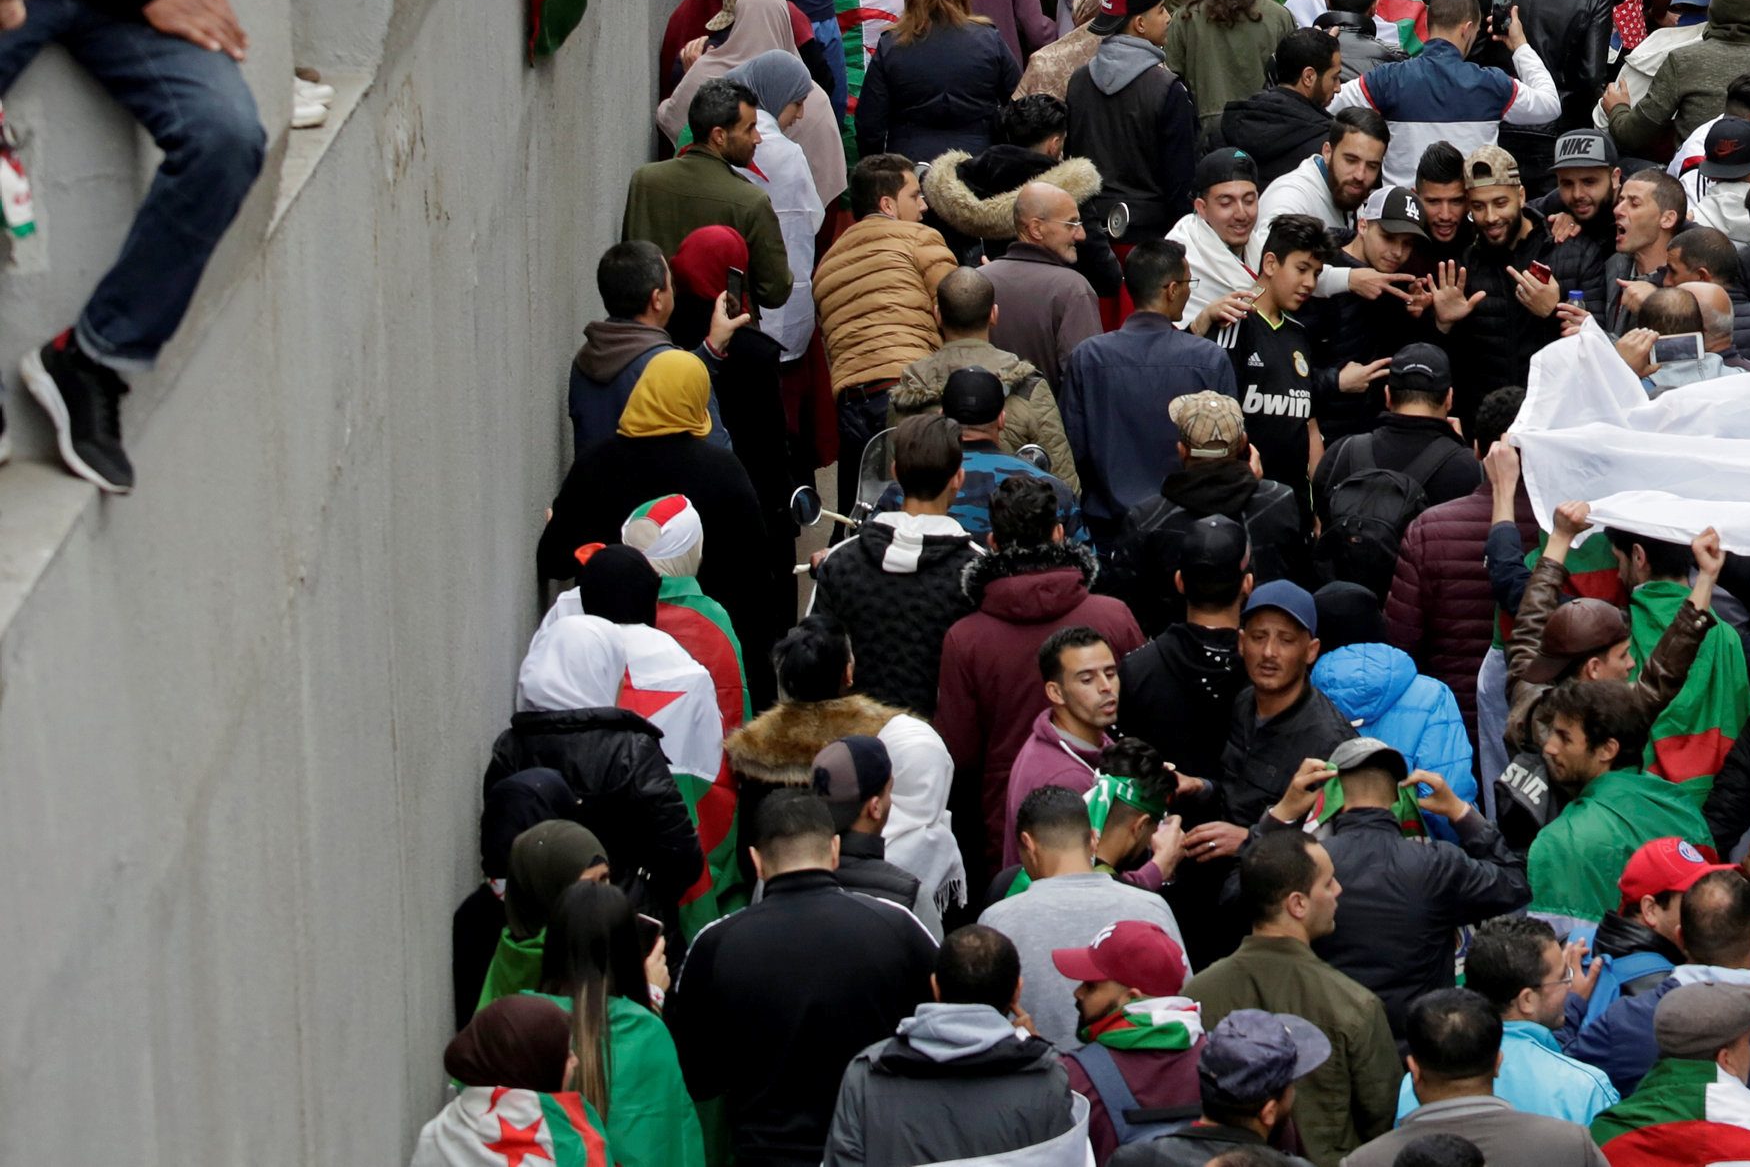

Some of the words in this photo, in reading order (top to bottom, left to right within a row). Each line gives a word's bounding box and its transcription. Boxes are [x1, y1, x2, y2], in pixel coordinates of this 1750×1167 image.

[1559, 137, 1595, 157] NIKE
[1405, 195, 1421, 221] LA
[1242, 384, 1311, 418] bwin
